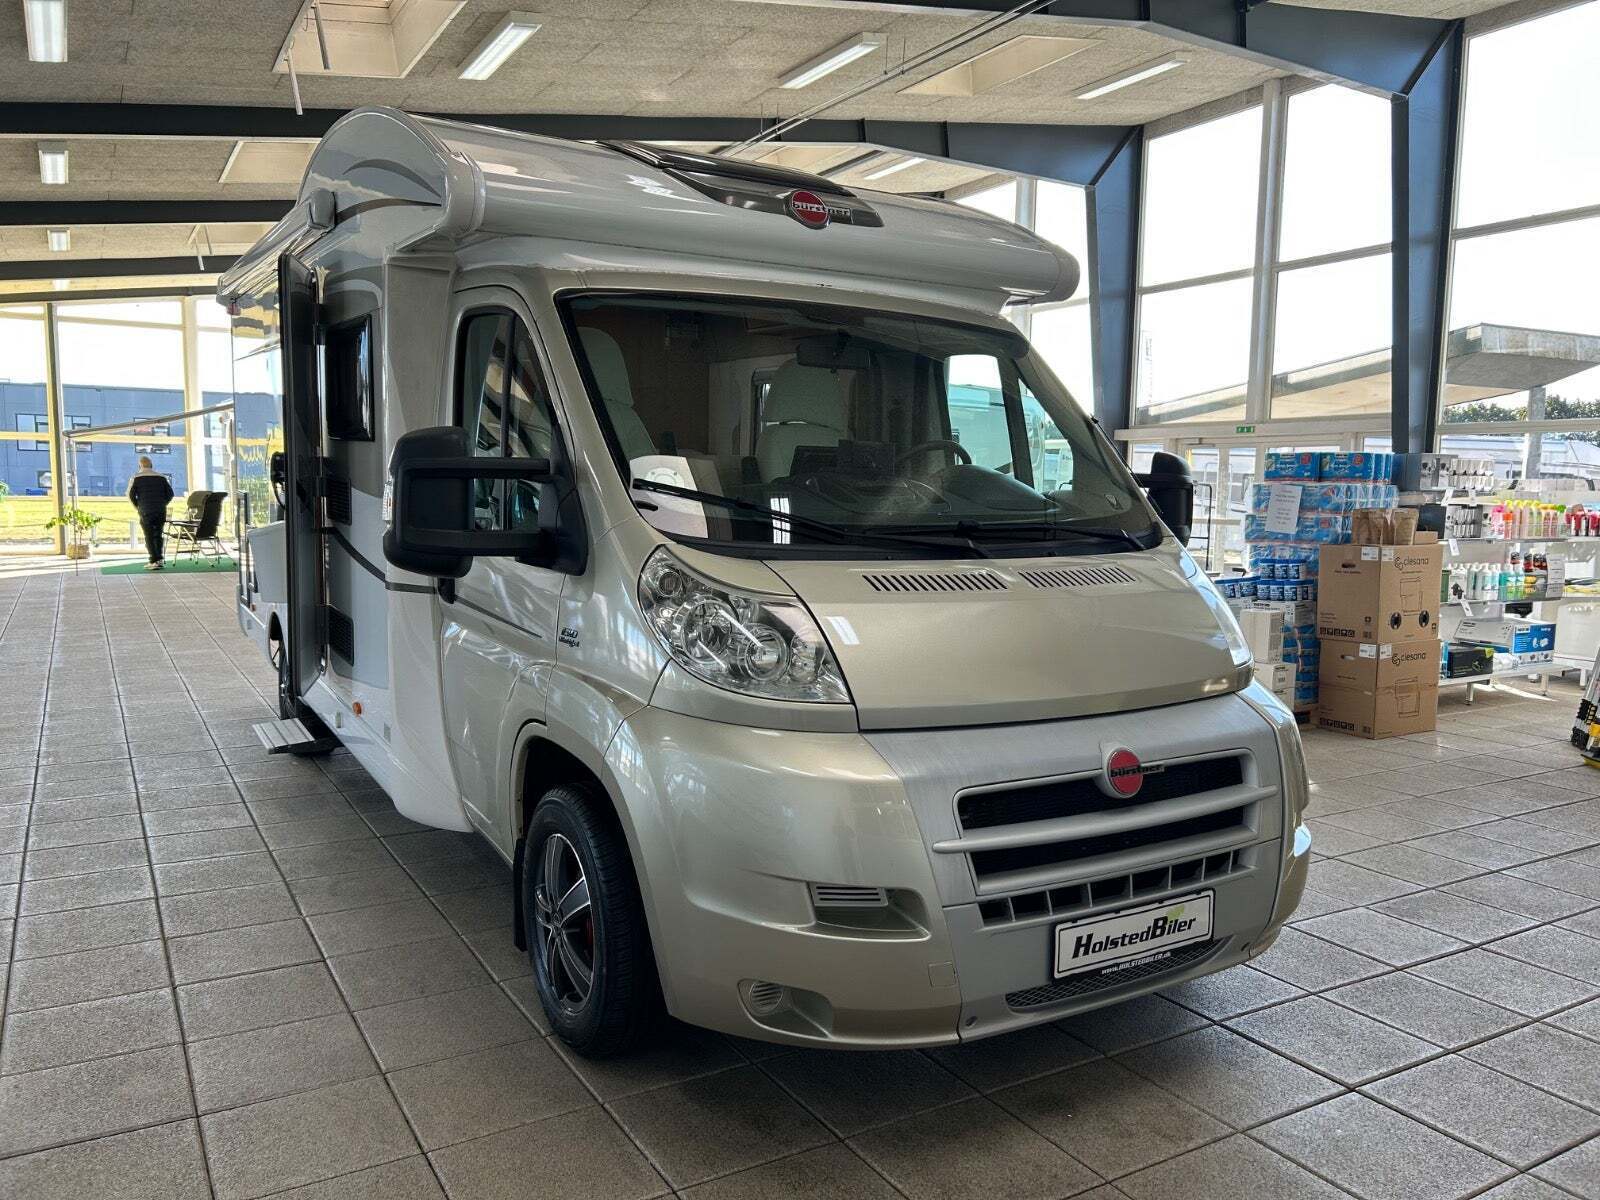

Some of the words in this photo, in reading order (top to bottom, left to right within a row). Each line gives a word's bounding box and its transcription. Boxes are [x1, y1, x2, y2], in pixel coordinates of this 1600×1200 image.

[792, 201, 850, 216] bürstner
[1403, 555, 1429, 566] clesana
[1401, 652, 1426, 662] clesana
[1071, 915, 1197, 960] HolstedBiler
